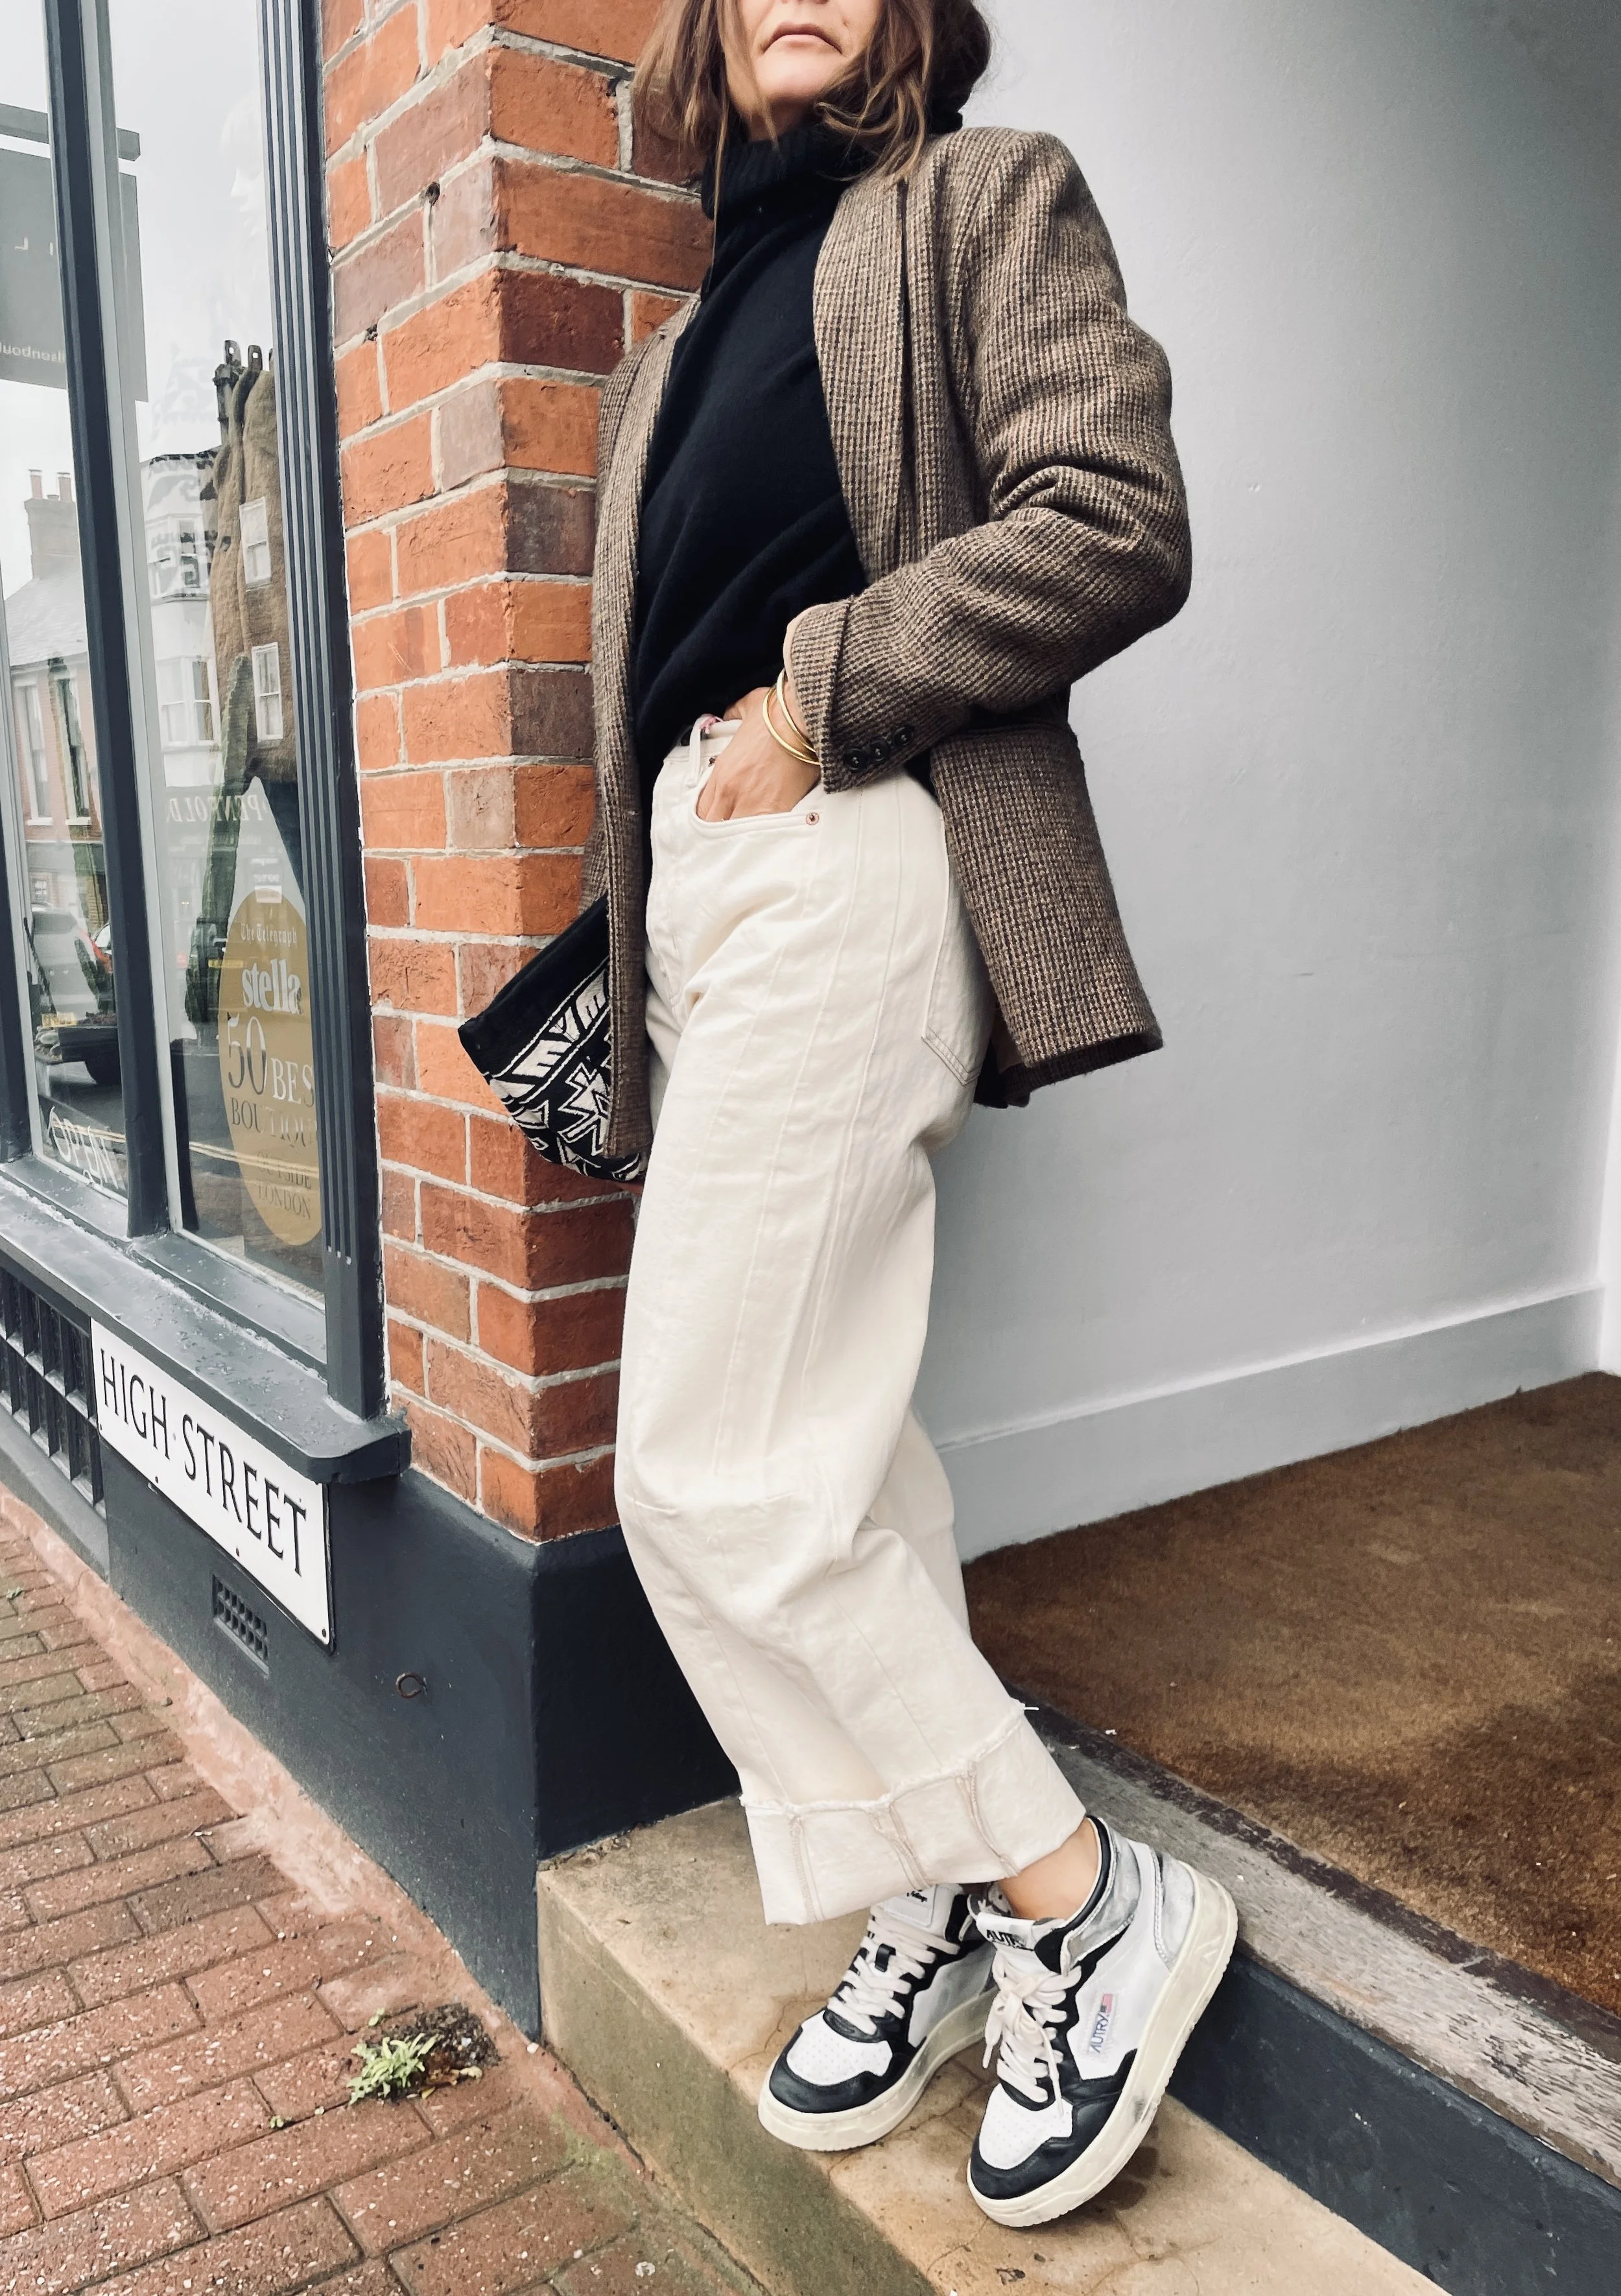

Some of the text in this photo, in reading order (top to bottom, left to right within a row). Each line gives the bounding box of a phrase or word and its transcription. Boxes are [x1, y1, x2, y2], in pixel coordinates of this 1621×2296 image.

[241, 923, 298, 947] The Telegraph
[242, 958, 302, 1015] stella
[228, 1012, 315, 1107] 50 BES
[257, 1182, 311, 1220] LONDON
[101, 1348, 307, 1577] HIGH STREET
